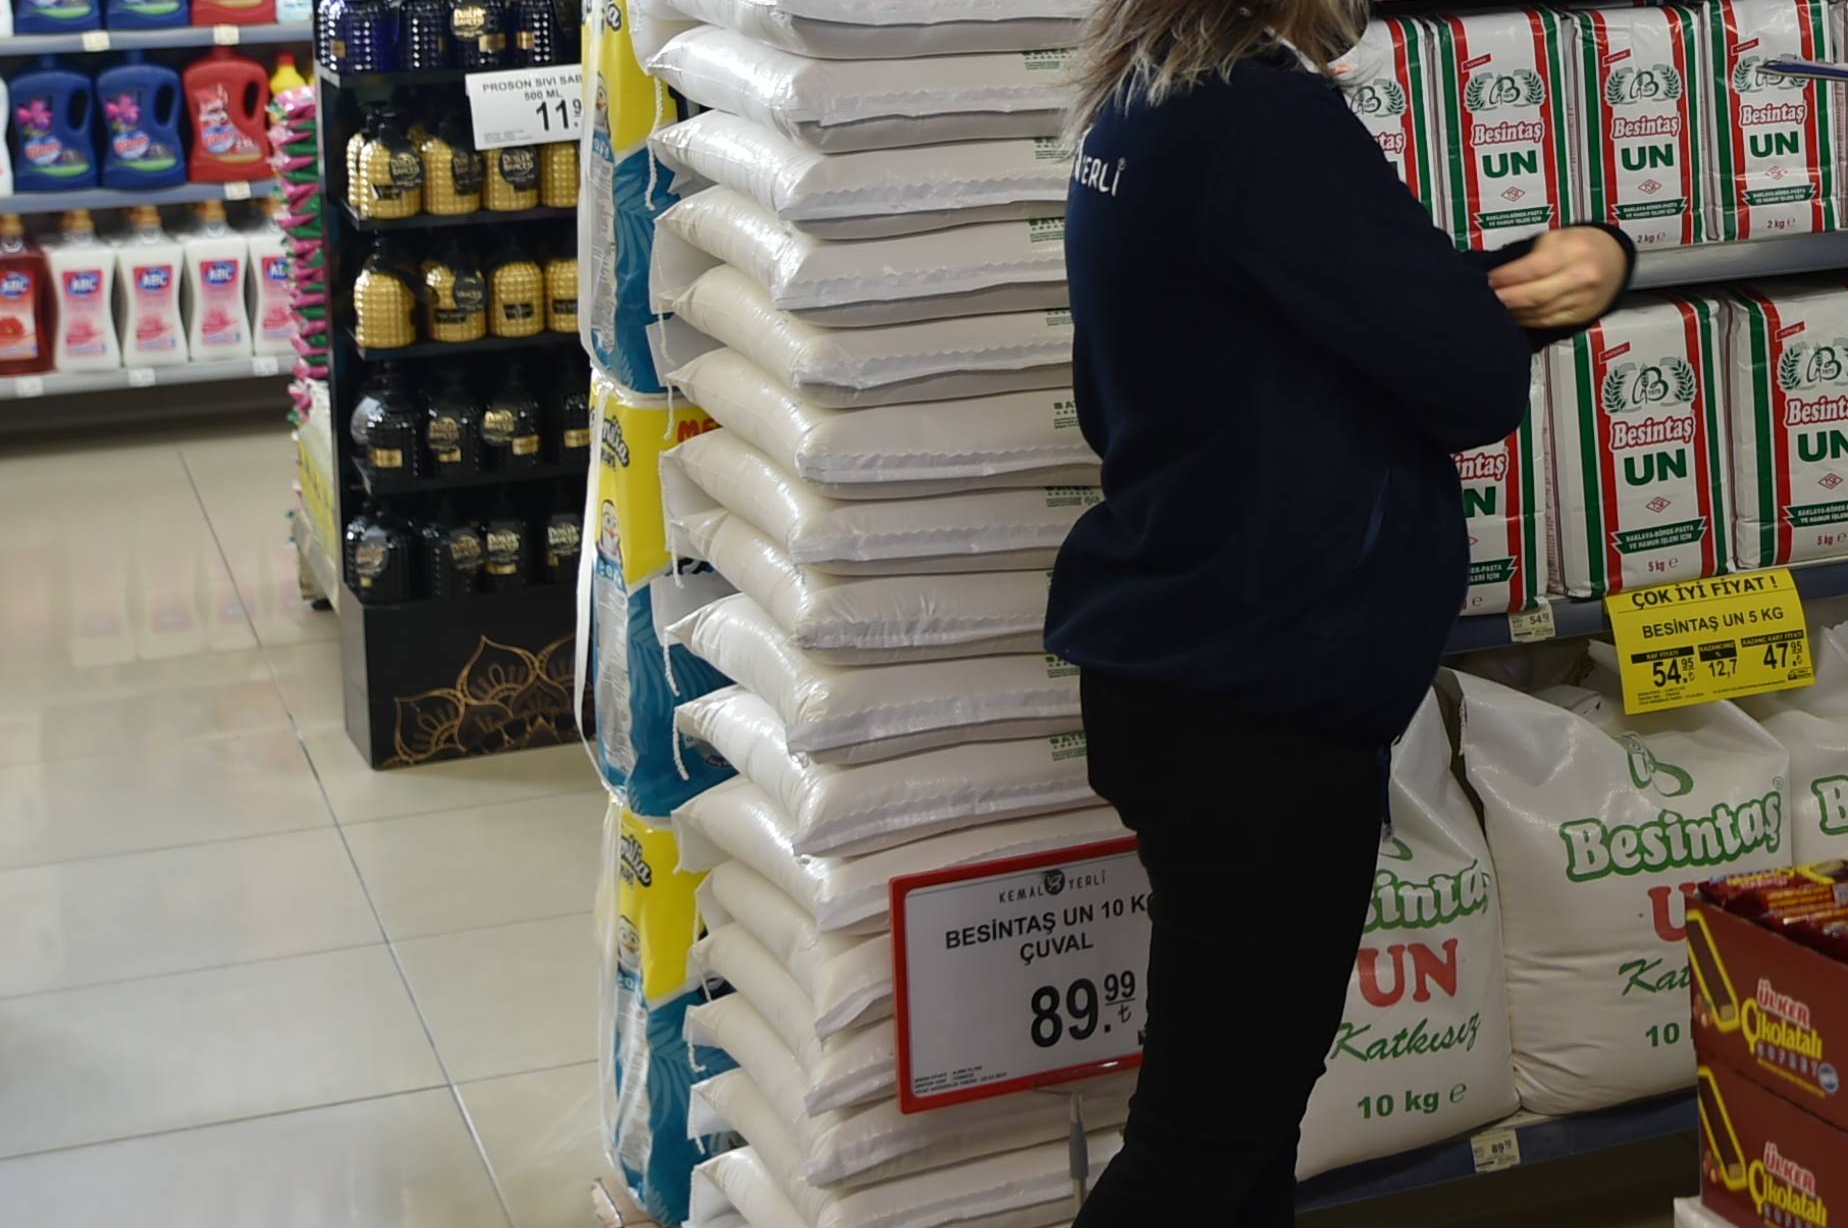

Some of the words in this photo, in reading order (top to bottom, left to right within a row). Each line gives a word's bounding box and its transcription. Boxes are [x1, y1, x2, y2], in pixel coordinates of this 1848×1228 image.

[482, 79, 532, 93] PROSON
[560, 75, 582, 86] SAB
[524, 91, 543, 101] 500
[546, 90, 562, 98] ML
[536, 99, 582, 132] 11.9
[1739, 102, 1806, 127] Besintaş
[1471, 120, 1544, 147] Besintaş
[1749, 131, 1799, 157] UN
[1482, 149, 1538, 178] UN
[1767, 219, 1772, 228] 2
[1774, 219, 1785, 230] kg
[1610, 417, 1695, 452] Besintaş
[1624, 448, 1688, 486] UN
[1817, 535, 1822, 545] 5
[1824, 535, 1833, 546] kg
[1648, 561, 1653, 572] 5
[1656, 561, 1665, 572] kg
[1631, 588, 1672, 610] ÇOK
[1678, 583, 1706, 601] İYİ
[1710, 577, 1765, 600] FİYAT
[1642, 615, 1719, 639] BESİNTAŞ
[1723, 613, 1745, 627] UN
[1749, 611, 1758, 624] 5
[1762, 606, 1784, 621] KG
[1708, 659, 1737, 679] 12,7
[1560, 789, 1783, 883] Besintaş
[999, 885, 1044, 904] KEMAL
[1067, 870, 1108, 891] YERLİ
[945, 911, 1056, 950] BESİNTAŞ
[1063, 903, 1094, 927] UN
[1101, 898, 1124, 918] 10
[1130, 892, 1153, 913] K
[1019, 932, 1094, 966] ÇUVAL
[1357, 937, 1459, 1007] UN
[1756, 977, 1811, 1031] ÜLKER
[1330, 1012, 1482, 1063] Katkısız
[1357, 1093, 1395, 1121] 10
[1404, 1089, 1440, 1115] kg
